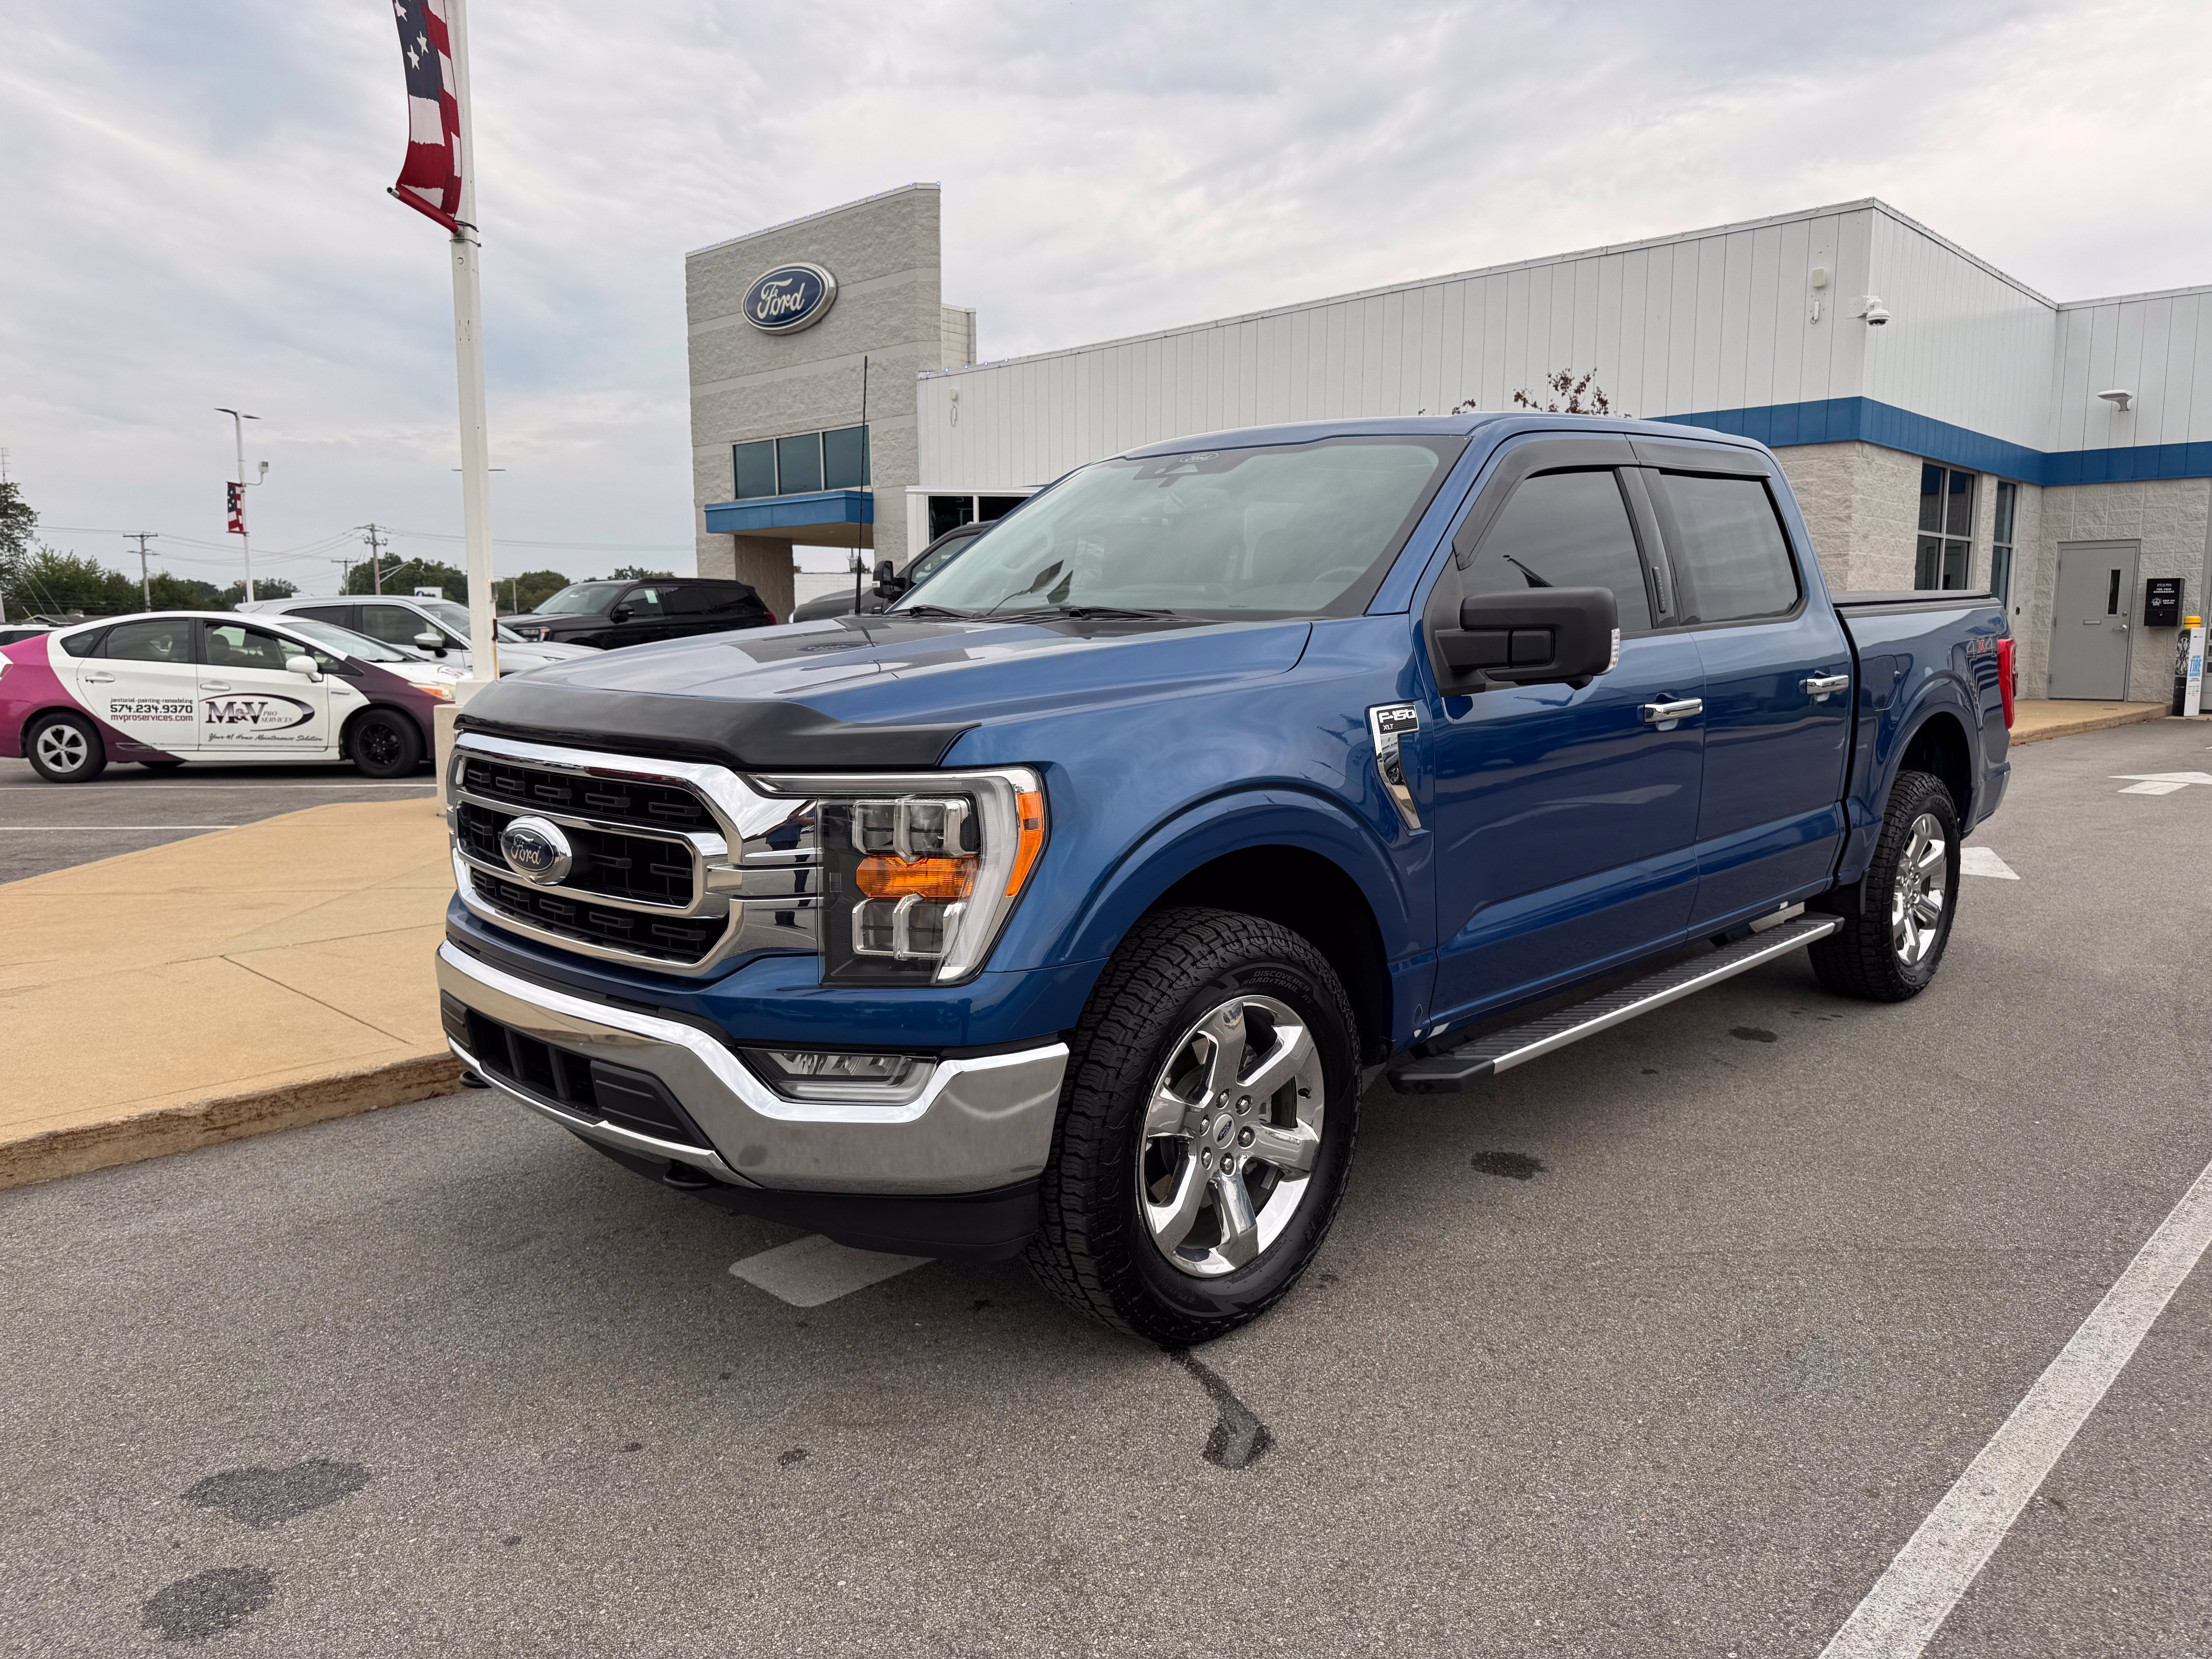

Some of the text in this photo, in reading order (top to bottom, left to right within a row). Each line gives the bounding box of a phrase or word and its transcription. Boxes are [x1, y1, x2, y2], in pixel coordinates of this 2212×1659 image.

[757, 278, 806, 319] Ford
[2190, 659, 2202, 672] TIRE
[110, 704, 193, 713] 574.234.9370
[1379, 709, 1416, 723] F-150
[208, 733, 224, 742] Your
[511, 834, 542, 865] Ford
[1253, 970, 1310, 992] DISCOVERER
[1241, 977, 1314, 1004] ROAD+TRAIL AT
[1220, 1123, 1230, 1139] Ford
